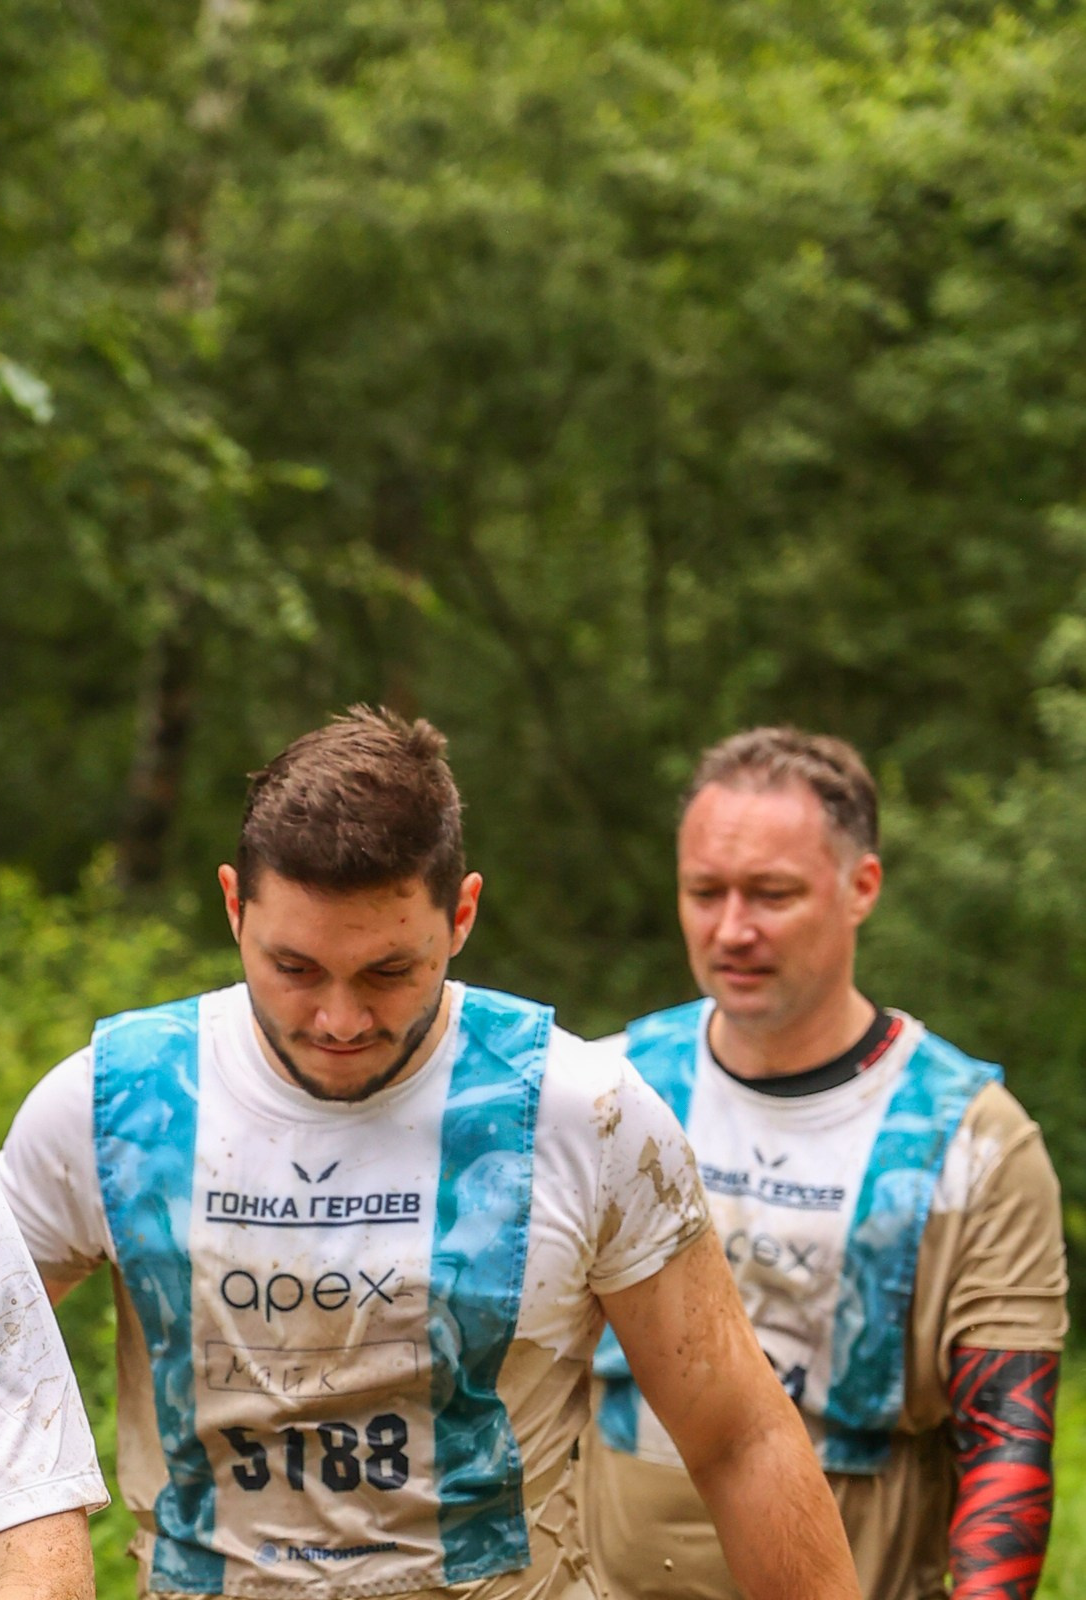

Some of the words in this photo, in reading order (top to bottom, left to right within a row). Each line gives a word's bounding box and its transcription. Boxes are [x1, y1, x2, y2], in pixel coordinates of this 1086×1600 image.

[206, 1191, 299, 1219] ГОНКА
[309, 1193, 421, 1218] ГЕРОЕВ
[221, 1268, 396, 1323] apex
[219, 1413, 409, 1492] 5188
